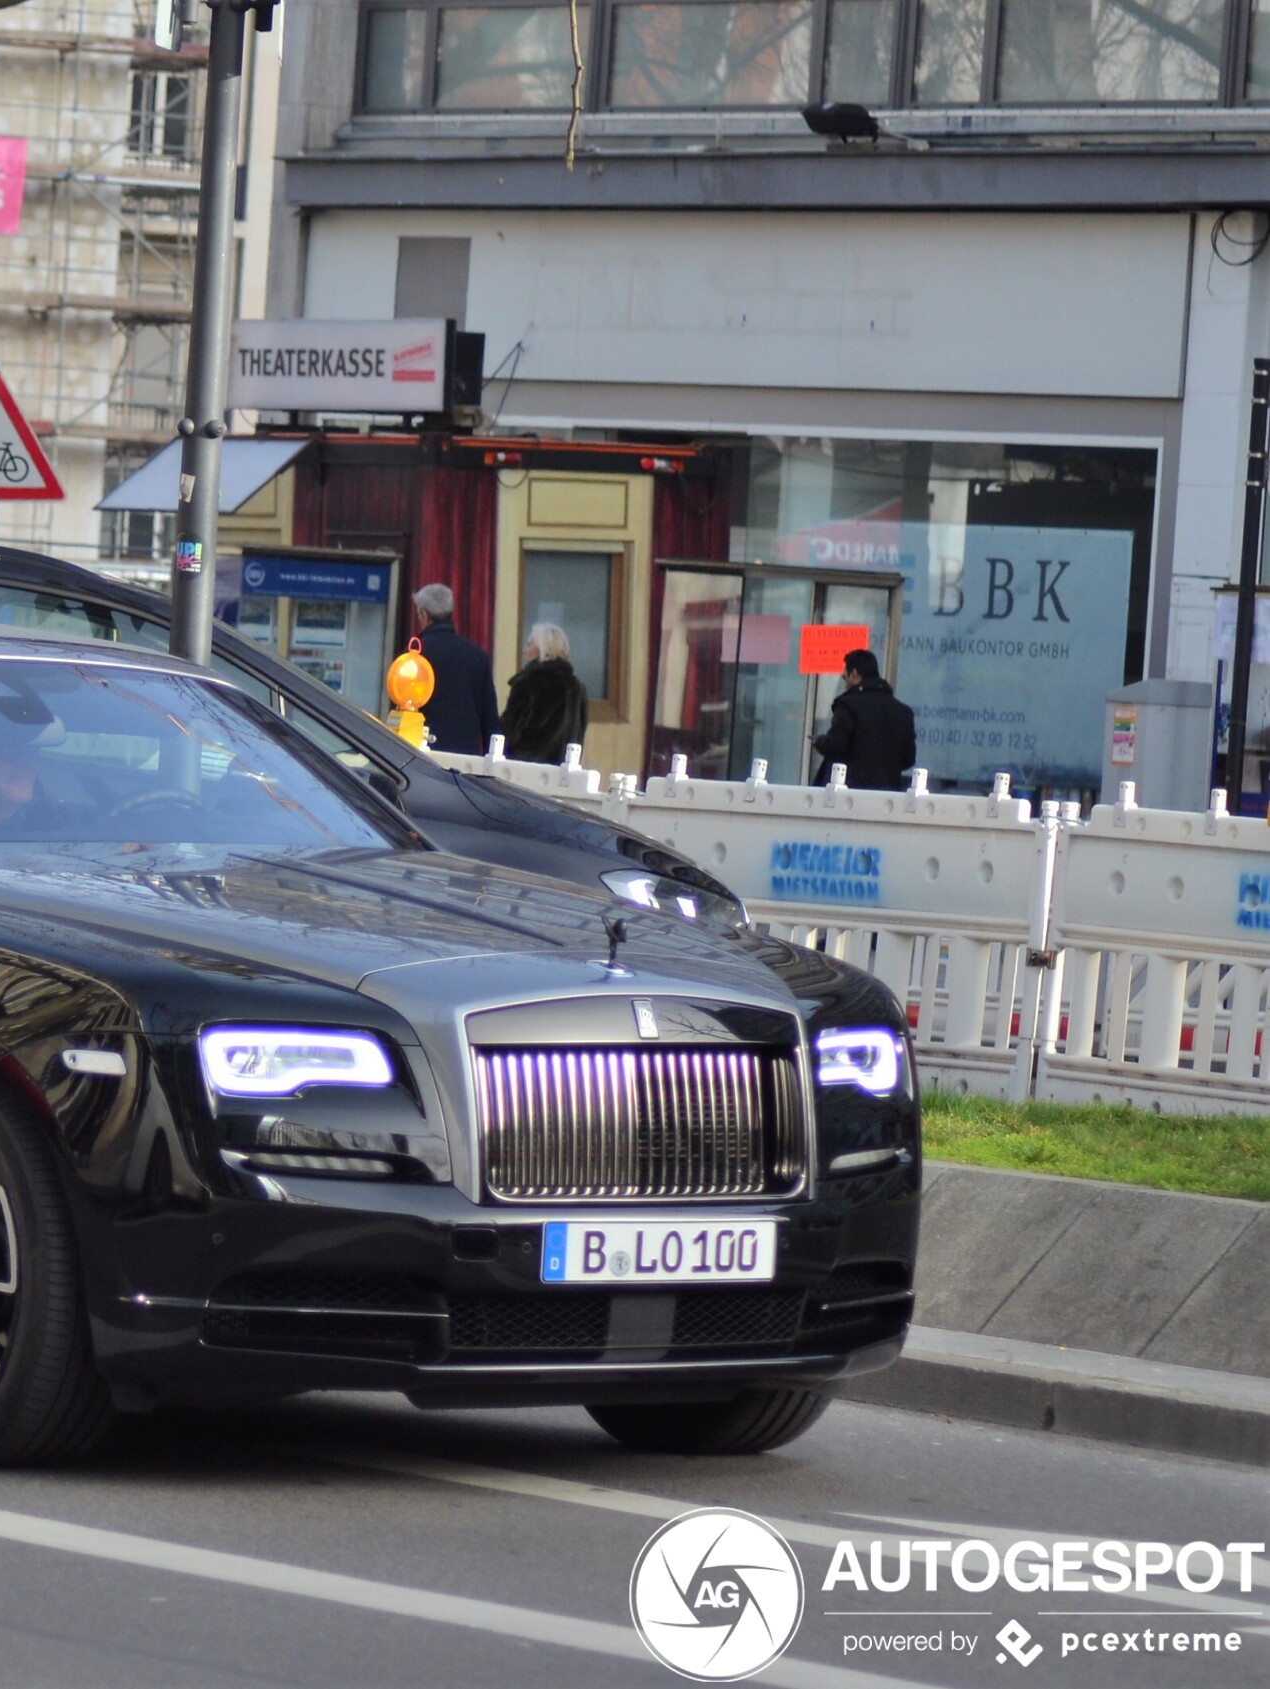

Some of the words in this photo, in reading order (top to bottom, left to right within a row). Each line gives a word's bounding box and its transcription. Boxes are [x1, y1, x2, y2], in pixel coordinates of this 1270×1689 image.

[238, 347, 385, 378] THEATERKASSE
[940, 634, 1023, 658] BAUKONTOR
[1029, 641, 1070, 659] GMBH
[771, 875, 880, 900] MIETSTATION
[550, 1257, 560, 1271] D
[582, 1230, 607, 1274] B
[691, 1229, 759, 1273] 100
